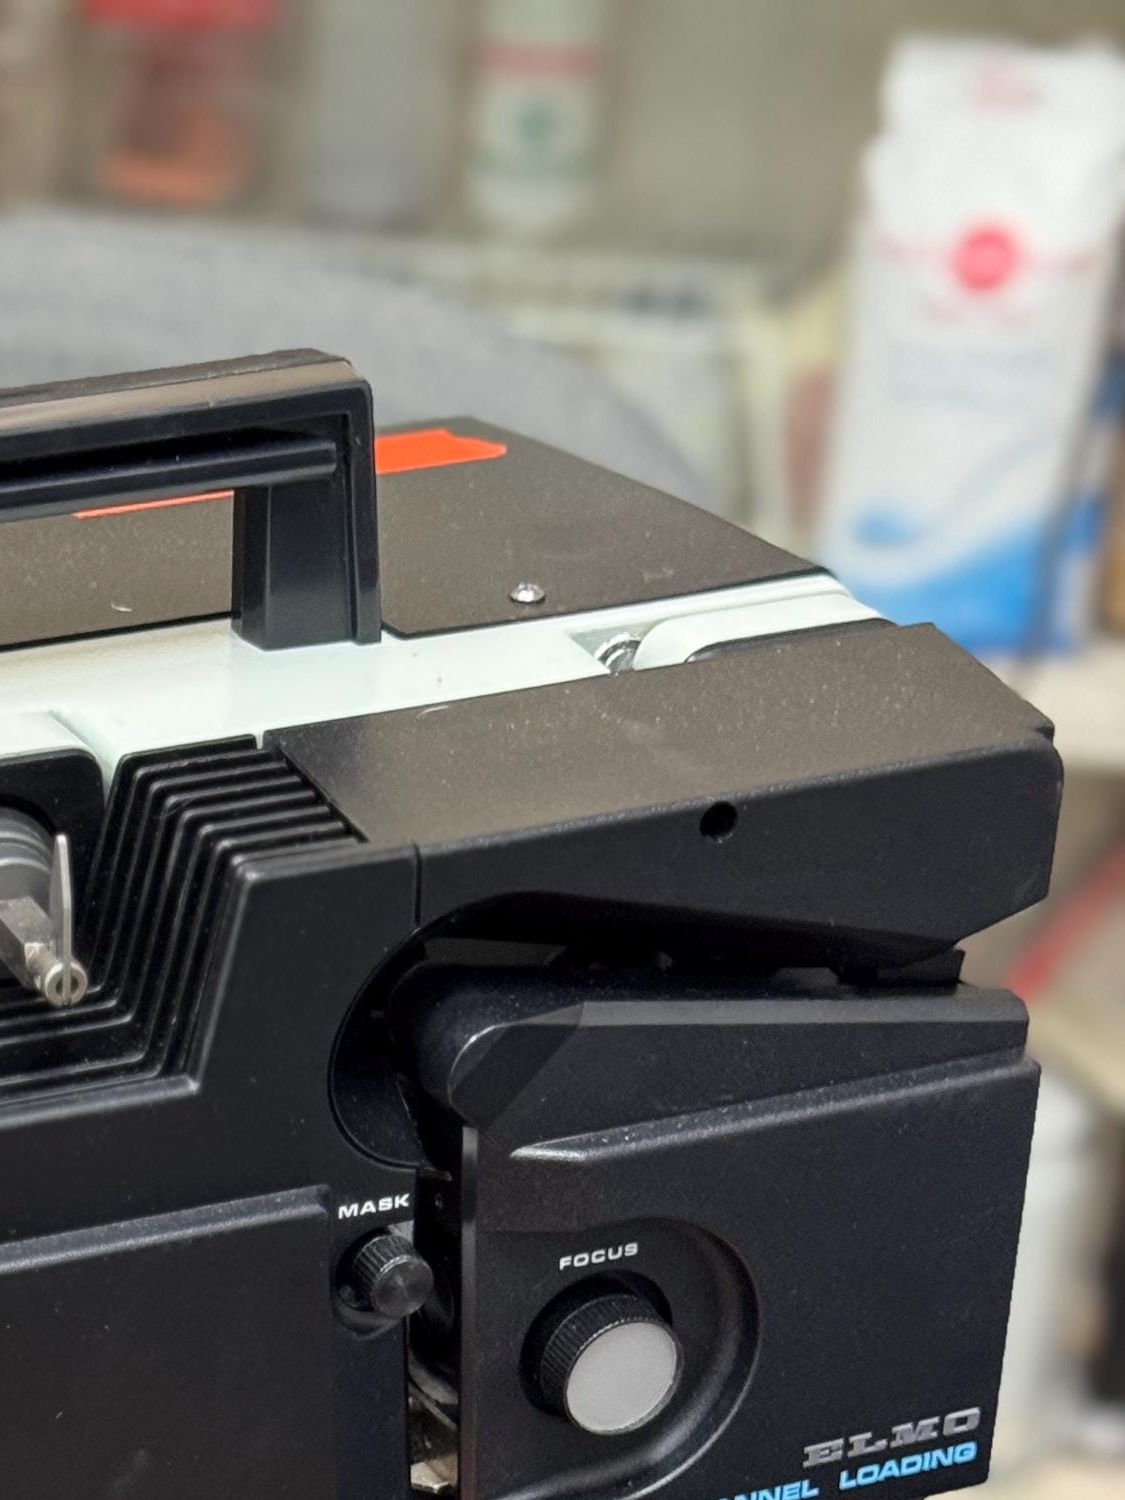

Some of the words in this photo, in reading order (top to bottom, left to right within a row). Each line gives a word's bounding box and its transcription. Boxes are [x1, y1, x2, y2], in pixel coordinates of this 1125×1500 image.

[338, 1194, 410, 1219] MASK
[559, 1242, 639, 1270] FOCUS
[802, 1407, 981, 1468] ELMO
[838, 1441, 979, 1490] LOADING
